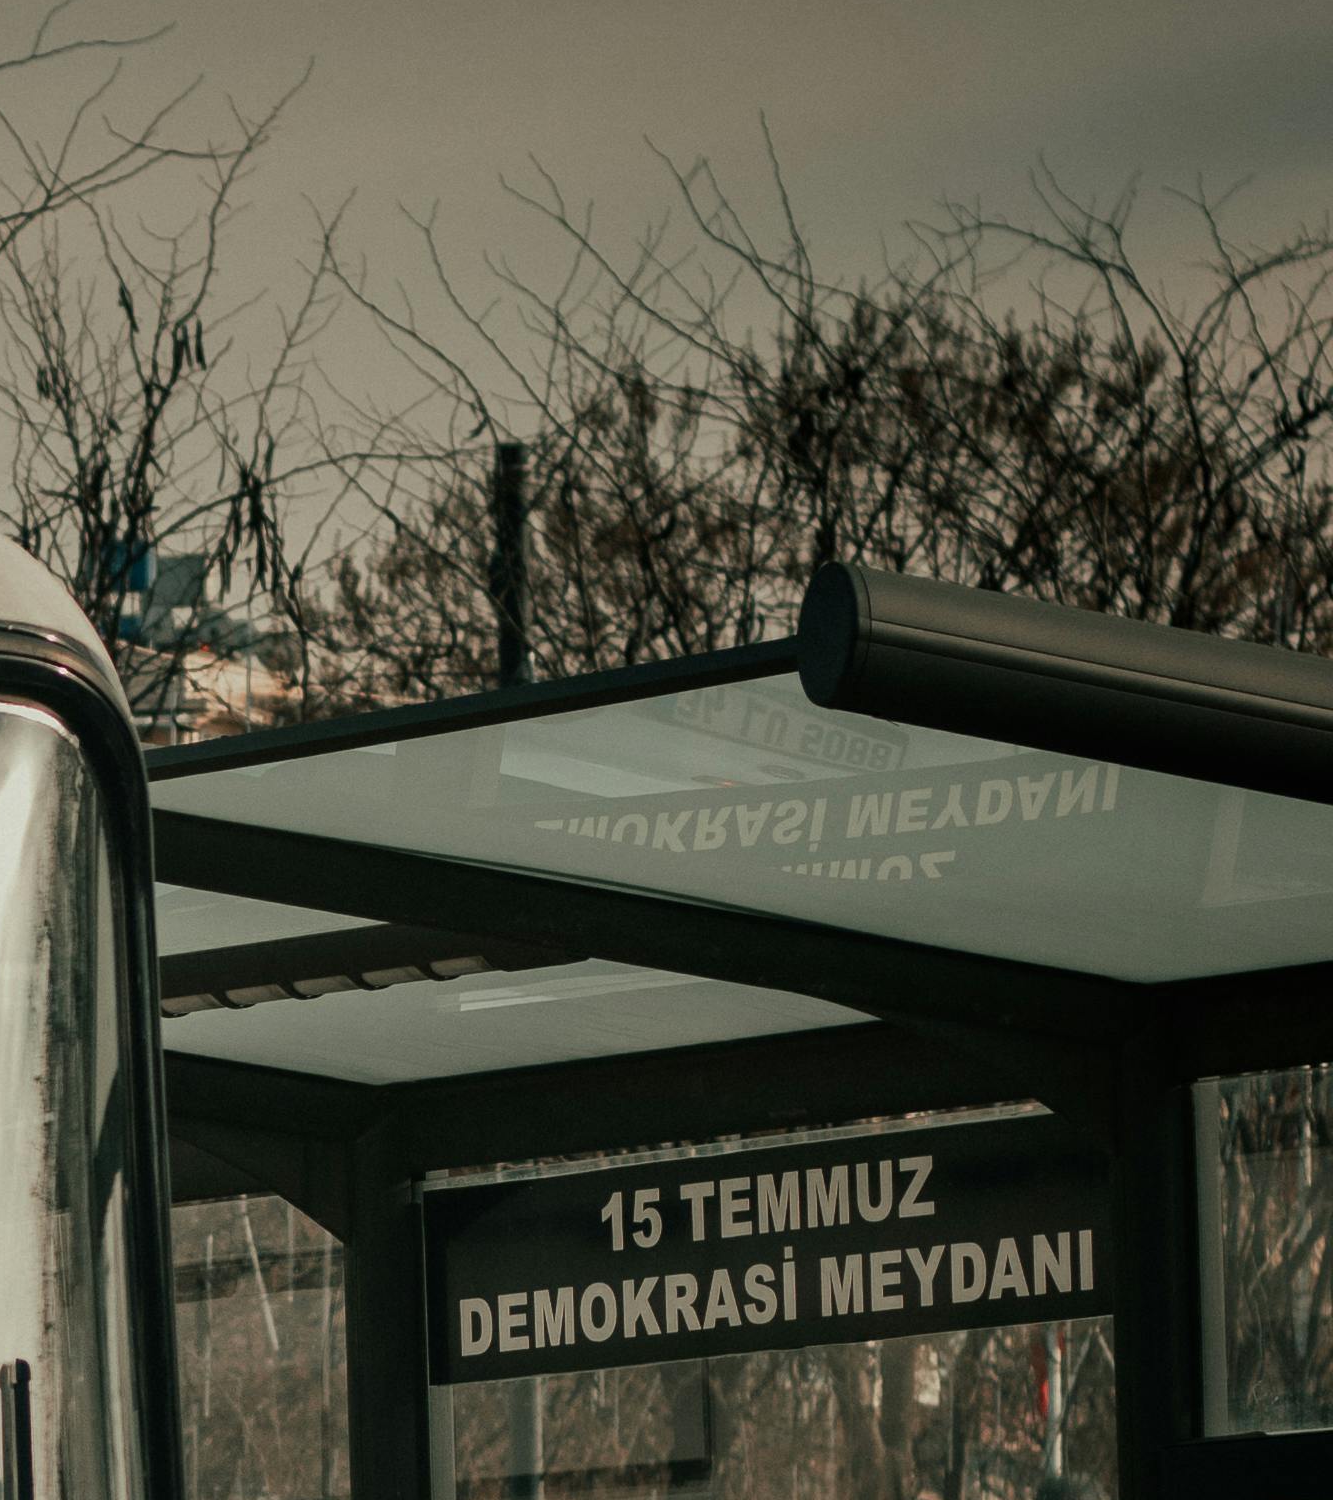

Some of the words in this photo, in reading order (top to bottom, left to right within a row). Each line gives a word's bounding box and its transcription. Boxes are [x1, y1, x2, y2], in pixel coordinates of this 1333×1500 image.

[600, 1188, 663, 1252] 15
[679, 1155, 936, 1242] TEMMUZ
[459, 1245, 798, 1357] DEMOKRASİ
[819, 1229, 1095, 1317] MEYDANI
